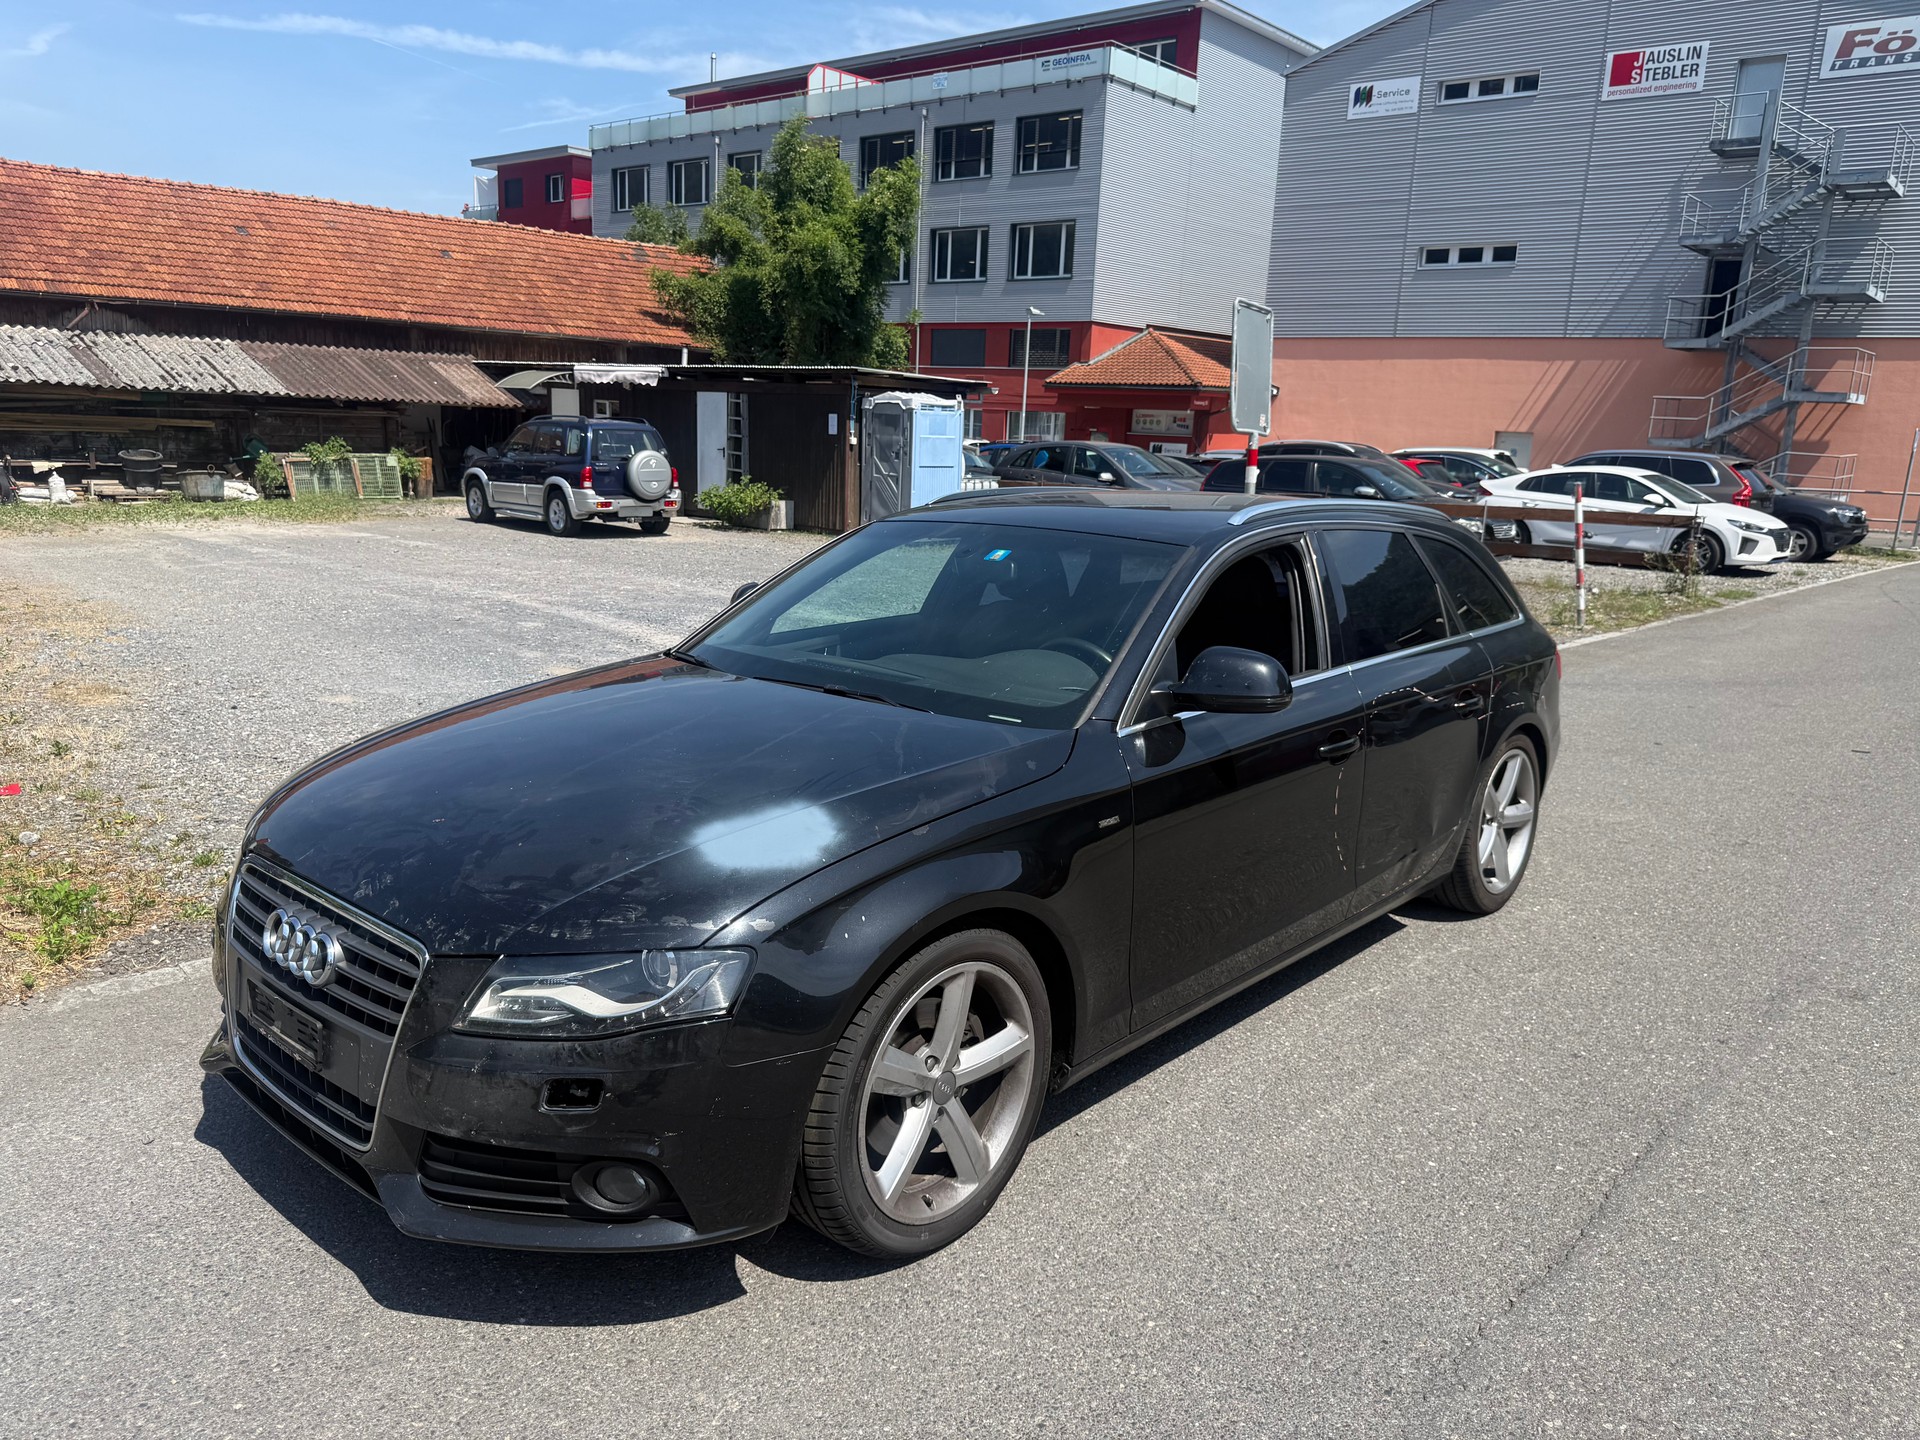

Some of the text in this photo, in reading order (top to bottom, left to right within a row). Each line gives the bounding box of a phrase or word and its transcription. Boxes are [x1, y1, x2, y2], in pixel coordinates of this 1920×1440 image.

[1834, 27, 1920, 60] Fö
[1052, 53, 1091, 67] GEOINFRA
[1633, 45, 1702, 67] JAUSLIN
[1630, 63, 1700, 84] STEBLER
[1607, 81, 1697, 98] personalized engineering
